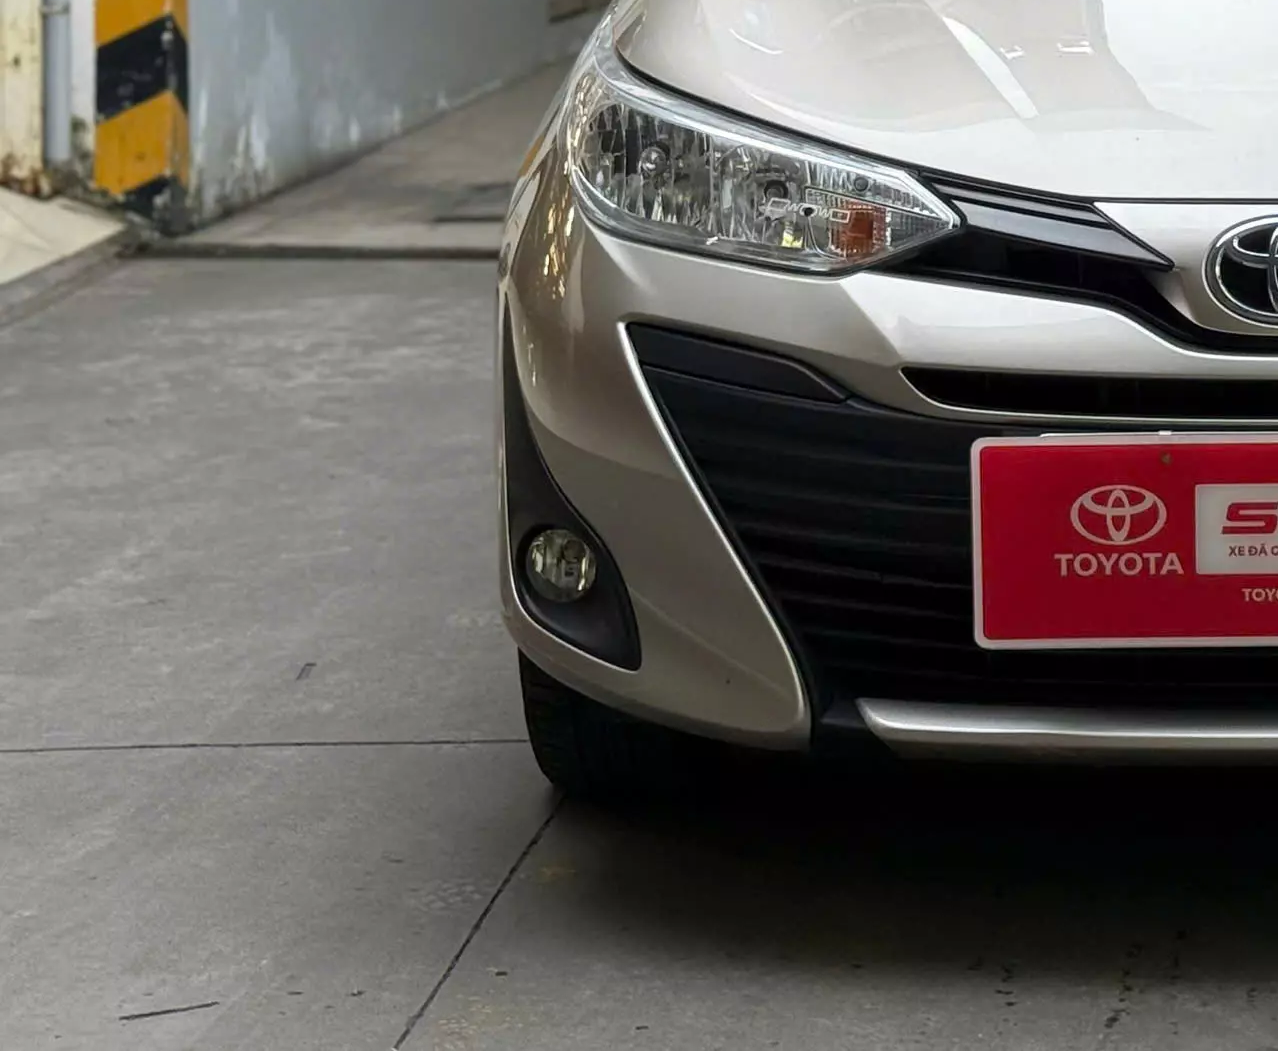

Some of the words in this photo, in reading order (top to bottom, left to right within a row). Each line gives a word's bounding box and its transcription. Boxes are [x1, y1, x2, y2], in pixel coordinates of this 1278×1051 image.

[1228, 545, 1245, 557] XE
[1247, 542, 1268, 557] ĐÃ
[1054, 552, 1184, 577] TOYOTA
